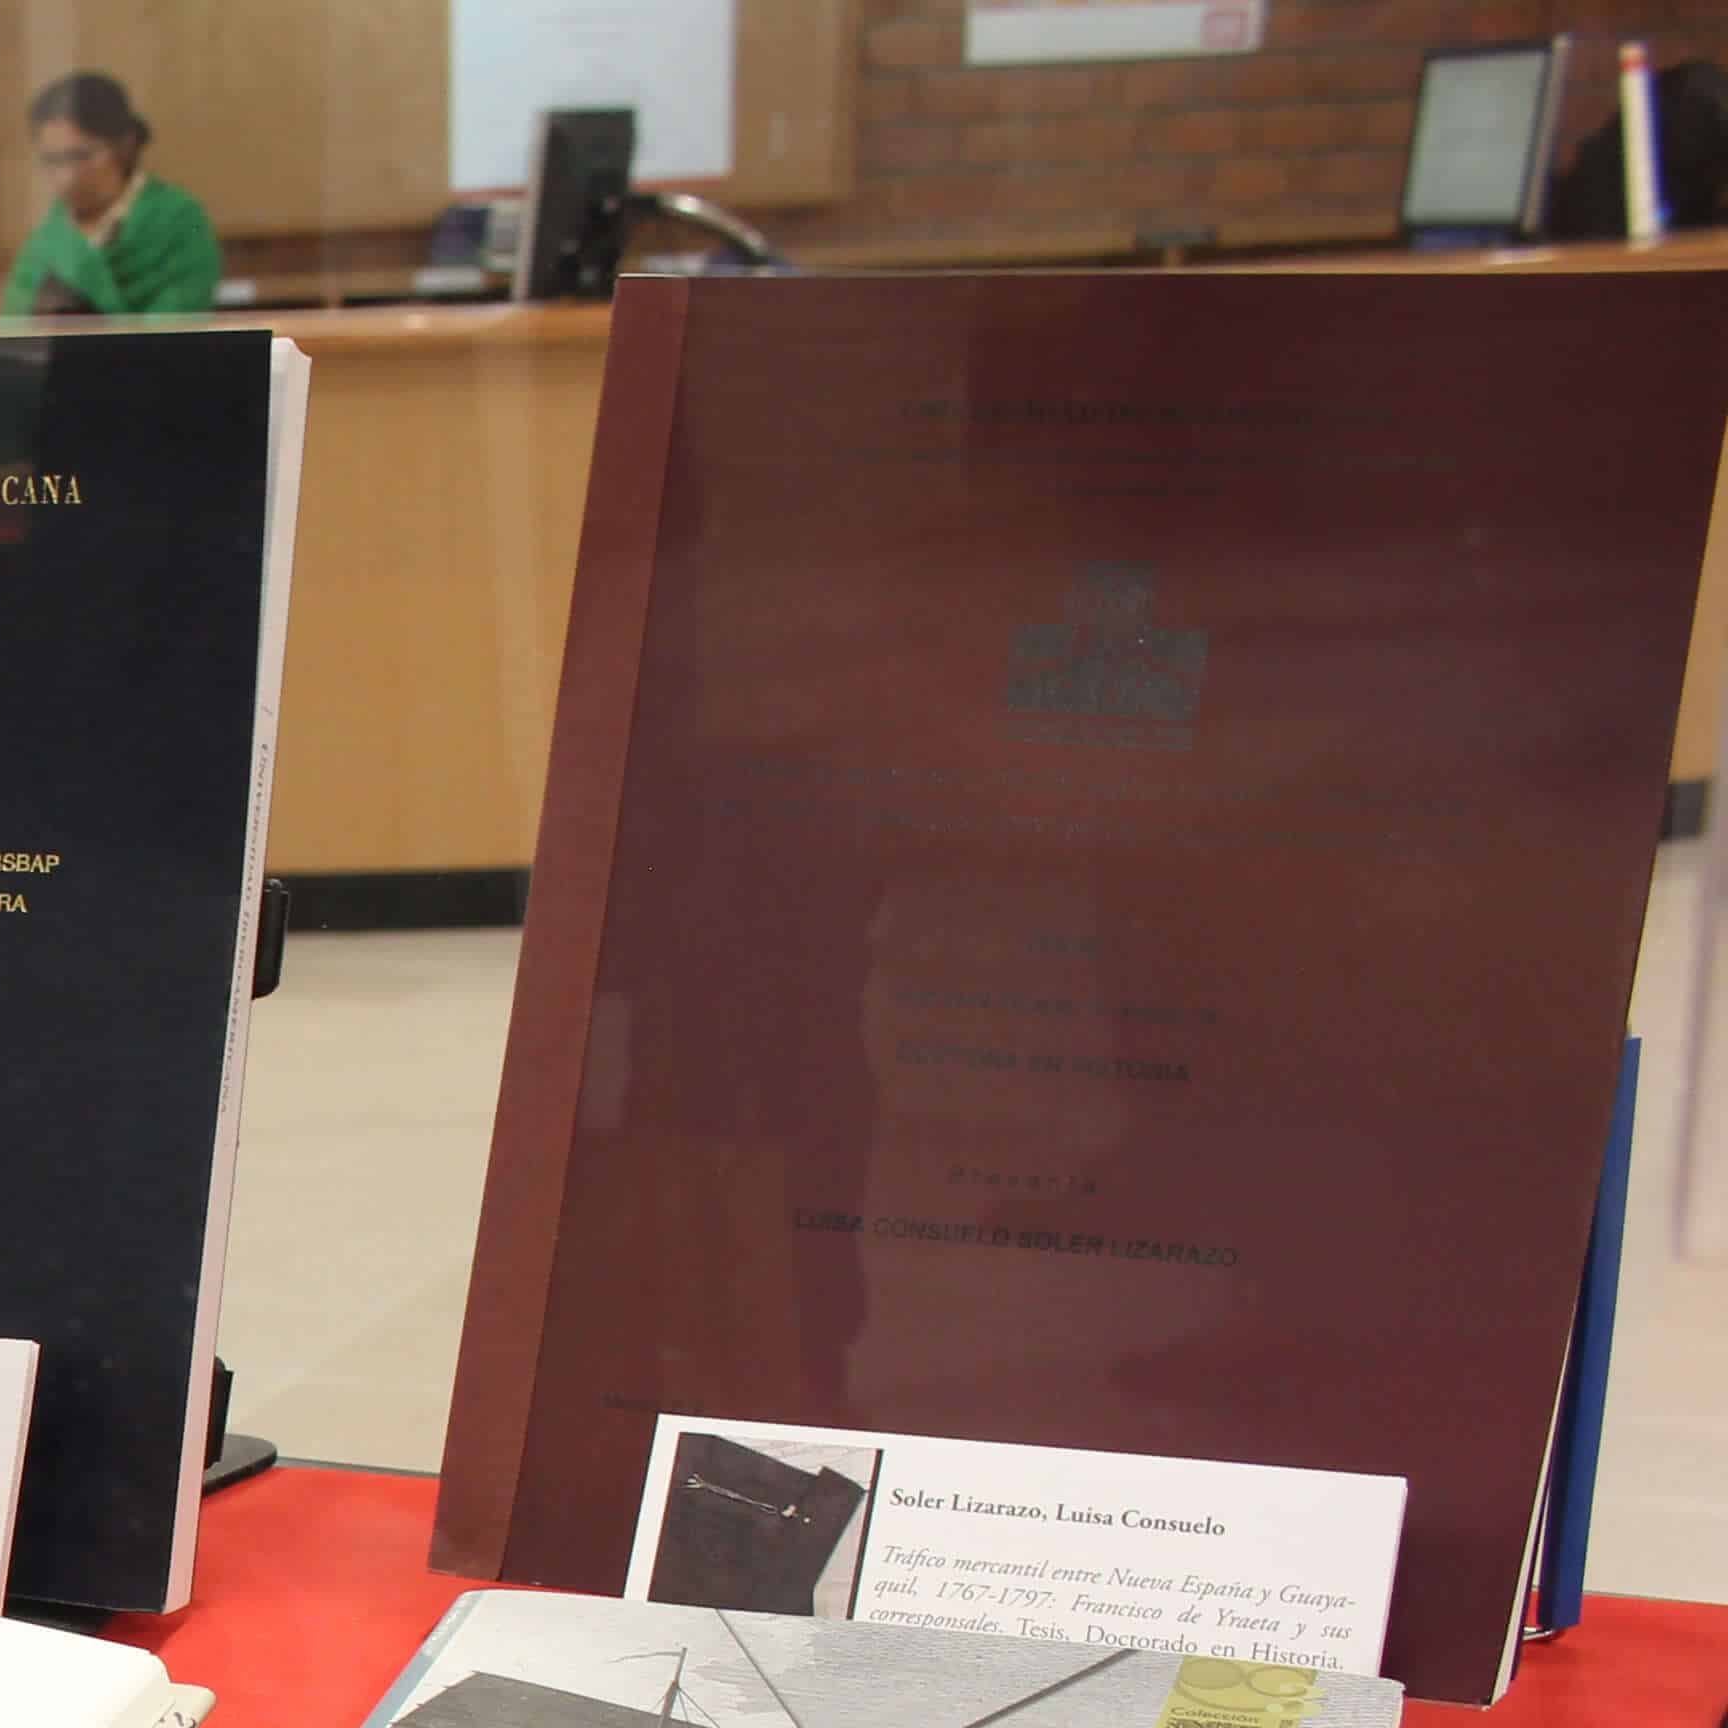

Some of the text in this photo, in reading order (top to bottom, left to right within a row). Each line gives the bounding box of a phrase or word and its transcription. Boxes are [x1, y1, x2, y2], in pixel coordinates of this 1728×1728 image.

[889, 1487, 1225, 1535] Soler Lizarazo, Luisa Consuelo
[881, 1544, 1356, 1612] Tráfico mercantil entre Nueva España y Guaya-
[873, 1578, 917, 1598] quil,
[1070, 1592, 1163, 1620] Francisco
[1175, 1603, 1202, 1624] de
[1215, 1607, 1280, 1632] Yraeta
[1294, 1622, 1307, 1638] y
[1319, 1624, 1352, 1640] sus
[1086, 1624, 1198, 1654] Doctorado
[1211, 1642, 1235, 1656] en
